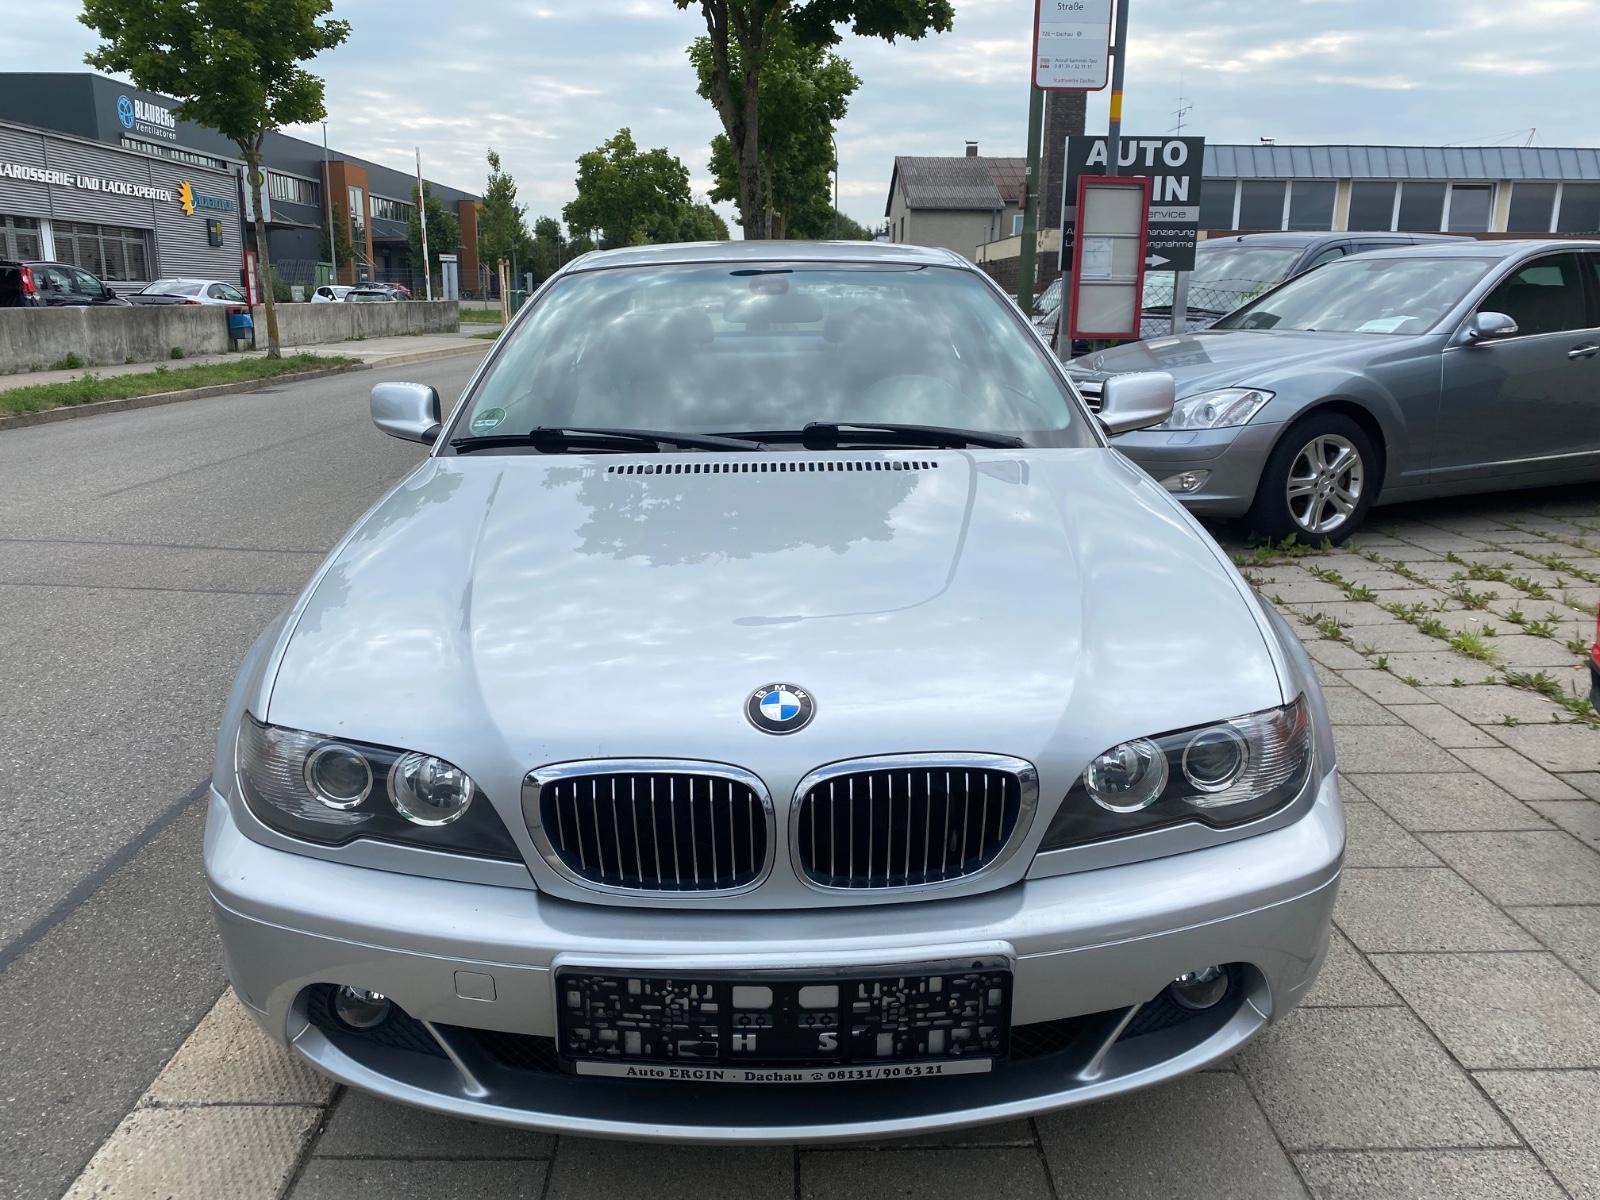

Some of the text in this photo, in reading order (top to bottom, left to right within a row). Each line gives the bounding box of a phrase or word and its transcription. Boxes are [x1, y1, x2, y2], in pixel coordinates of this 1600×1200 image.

[1057, 2, 1084, 11] Straße
[134, 99, 175, 128] BLAUBERG
[135, 122, 177, 140] Ventilatoren
[1085, 140, 1189, 167] AUTO
[76, 175, 99, 190] UND
[102, 179, 172, 201] LACKEXPERTEN
[1152, 175, 1190, 201] IN
[1148, 211, 1187, 219] ervice
[754, 684, 807, 698] BMW
[626, 1066, 665, 1078] Auto
[669, 1068, 725, 1080] ERGIN
[744, 1071, 803, 1082] Dachau
[904, 1066, 922, 1076] 63
[926, 1065, 943, 1074] 21
